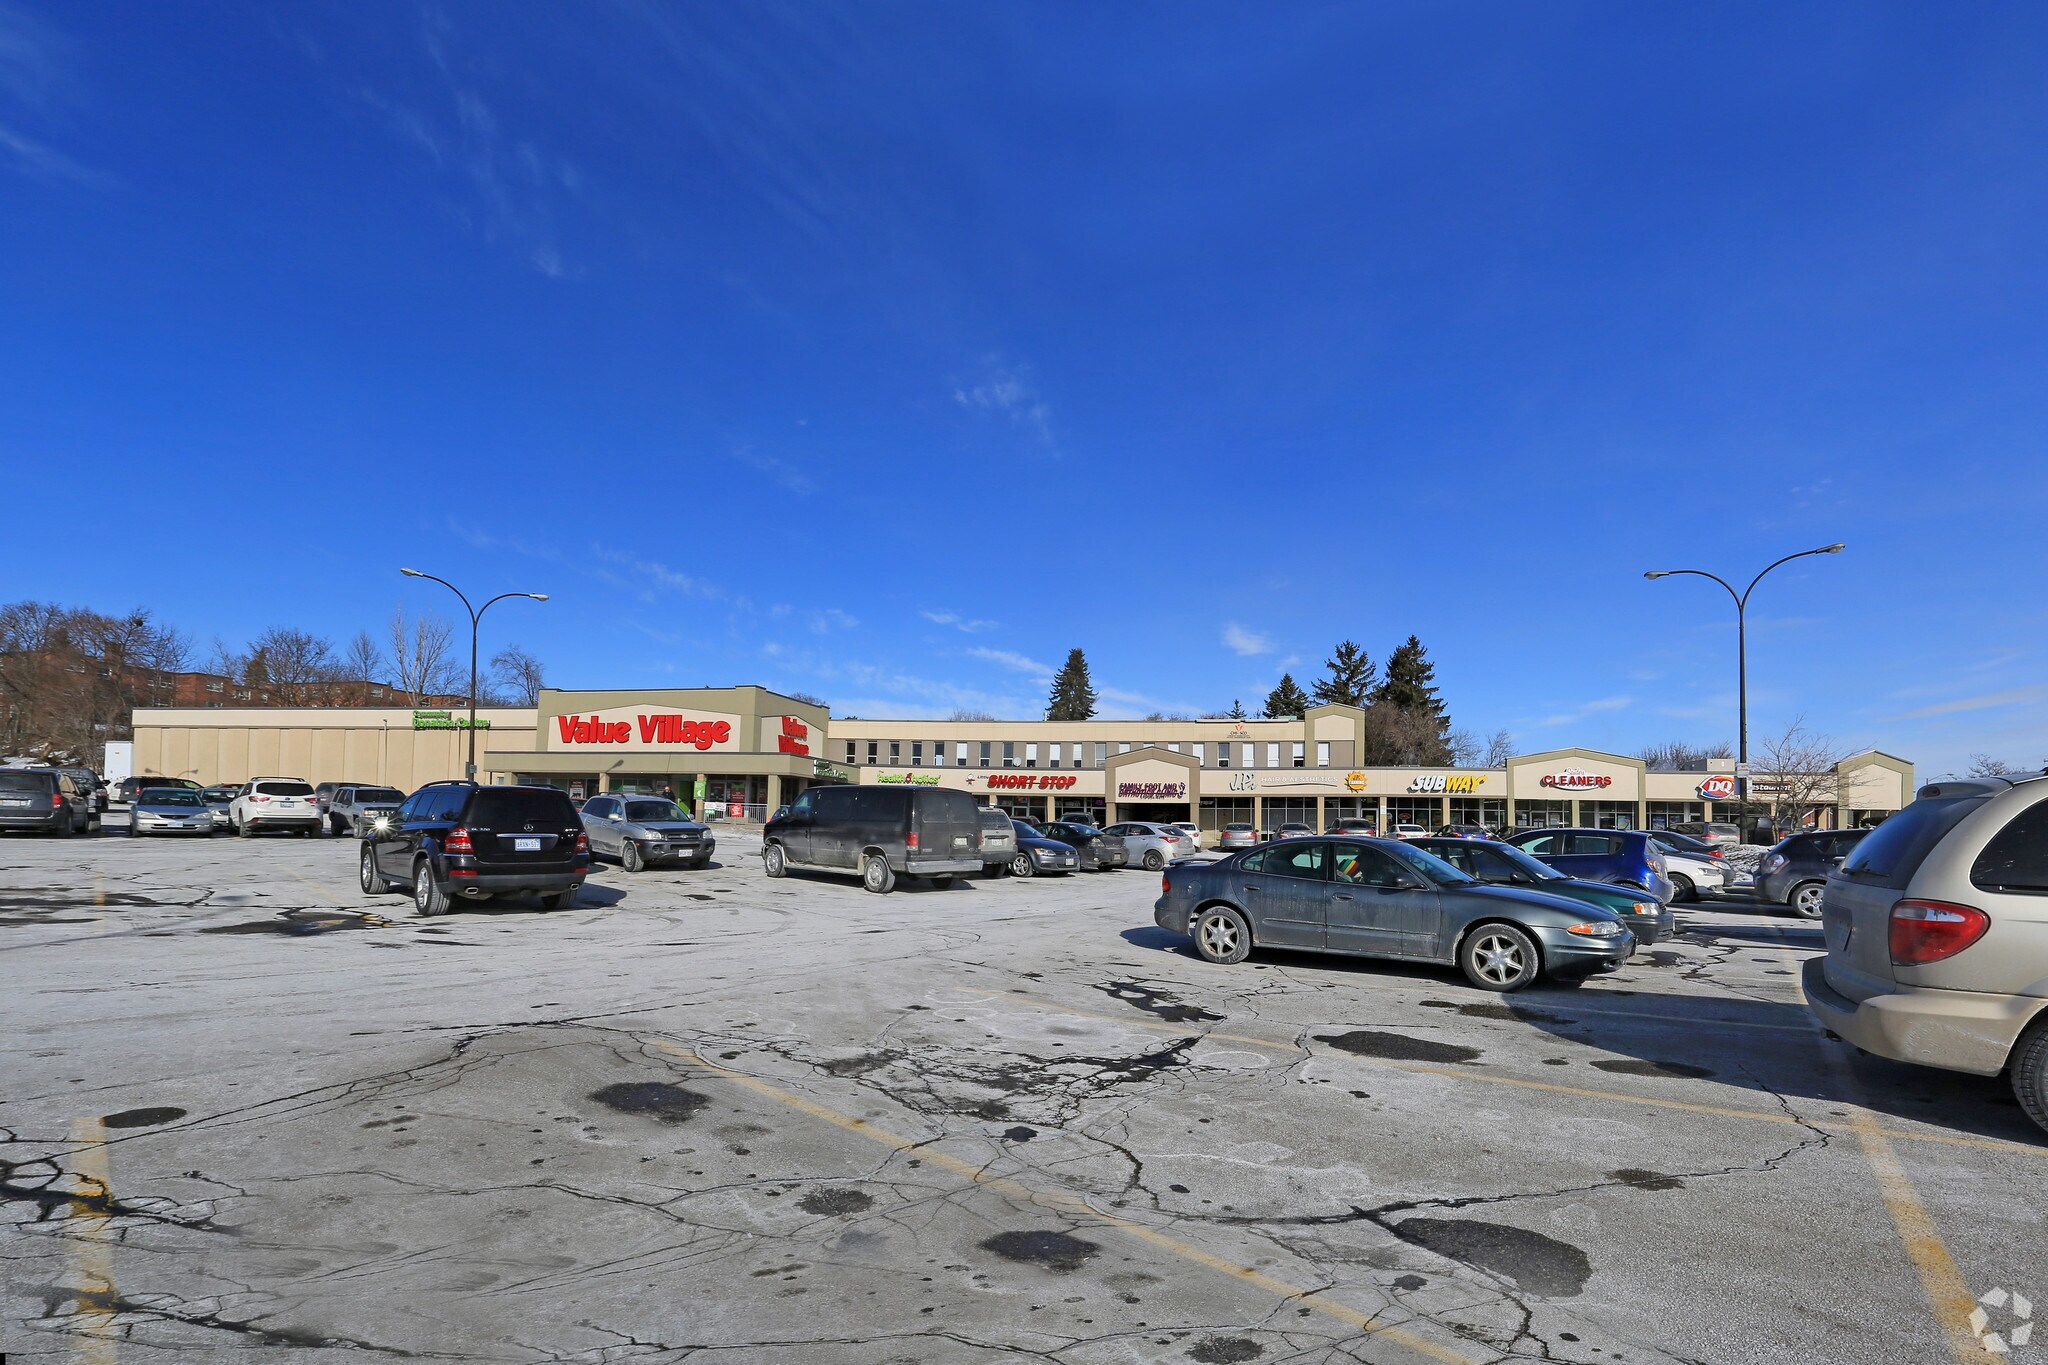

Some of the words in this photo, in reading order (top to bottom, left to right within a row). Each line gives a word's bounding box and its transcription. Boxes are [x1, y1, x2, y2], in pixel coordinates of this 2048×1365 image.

[558, 715, 632, 743] Value
[638, 715, 732, 750] Village
[782, 715, 807, 740] Value
[988, 775, 1037, 788] SHORT
[1039, 775, 1077, 789] STOP
[1411, 775, 1488, 791] SUBWAY
[1544, 775, 1612, 786] CLEANERS
[1707, 780, 1733, 794] DQ
